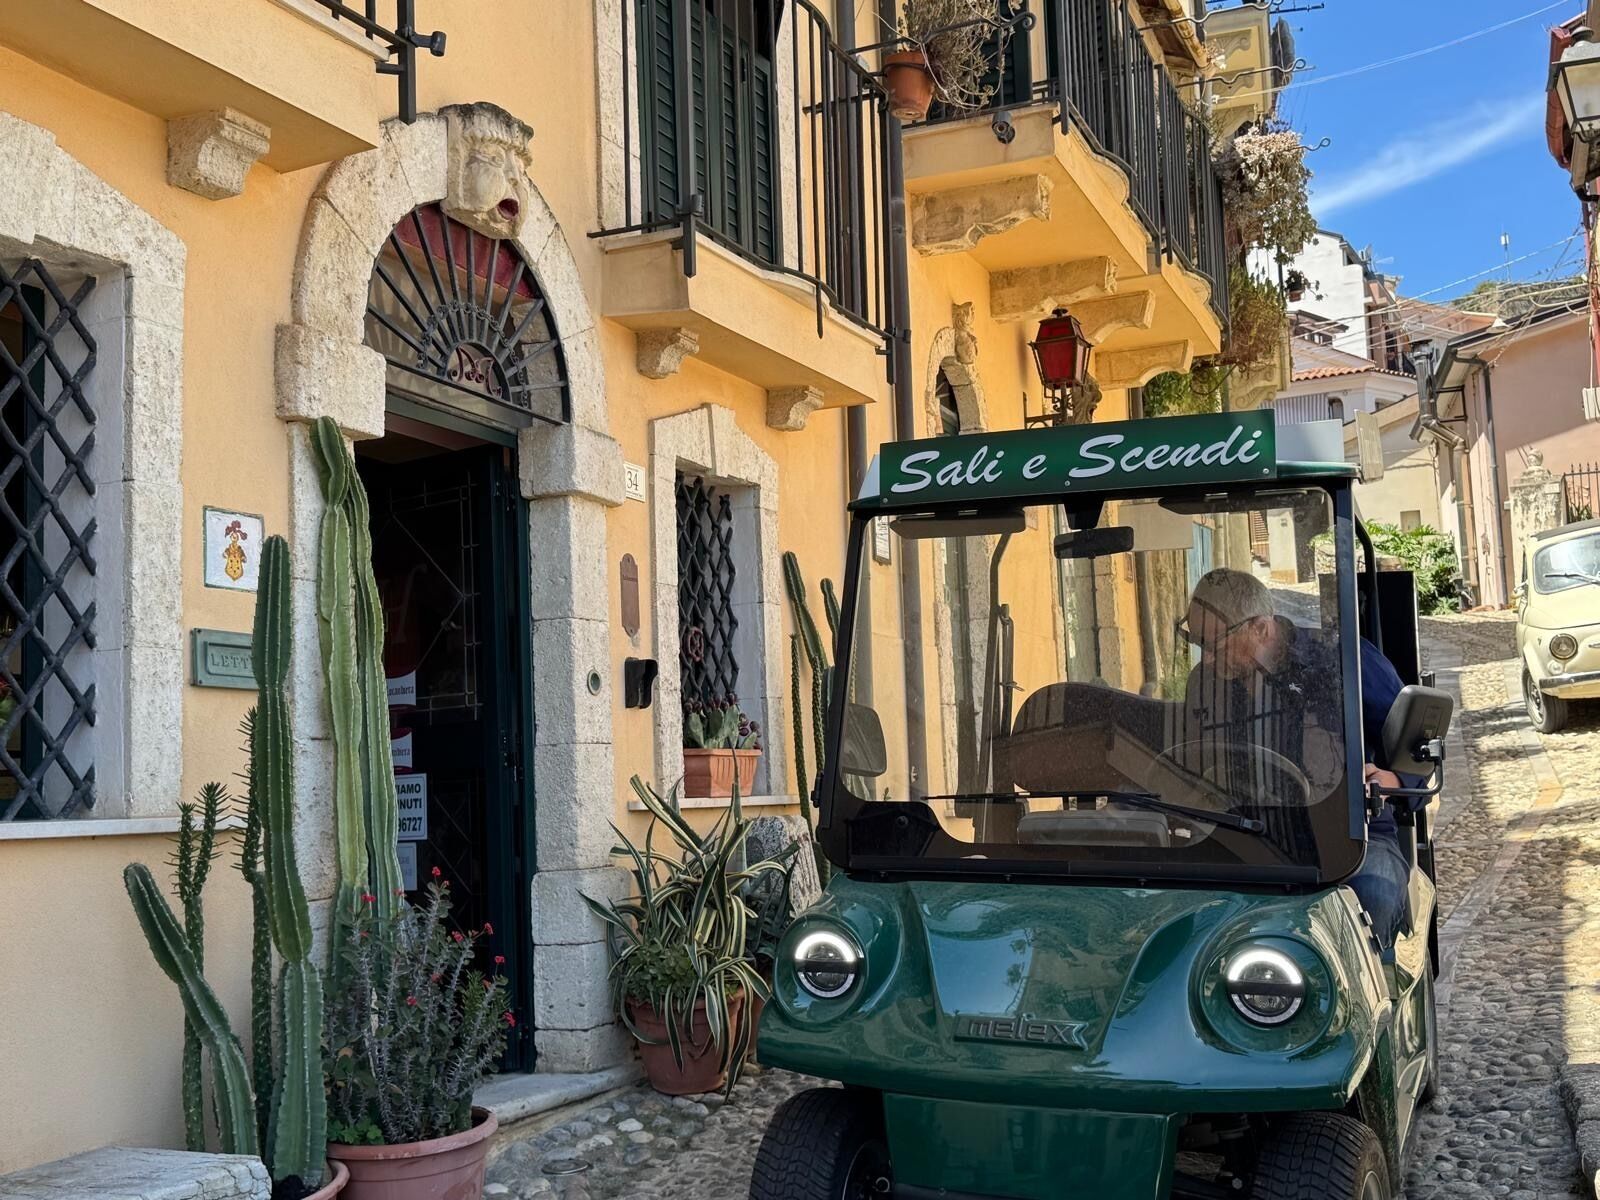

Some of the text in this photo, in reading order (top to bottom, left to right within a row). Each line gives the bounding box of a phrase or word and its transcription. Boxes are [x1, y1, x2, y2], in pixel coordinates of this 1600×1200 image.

[890, 424, 1263, 494] Sali e Scendi
[626, 470, 639, 491] 34
[210, 653, 250, 669] LETT
[397, 798, 422, 810] NUTI
[969, 1017, 1070, 1044] melex
